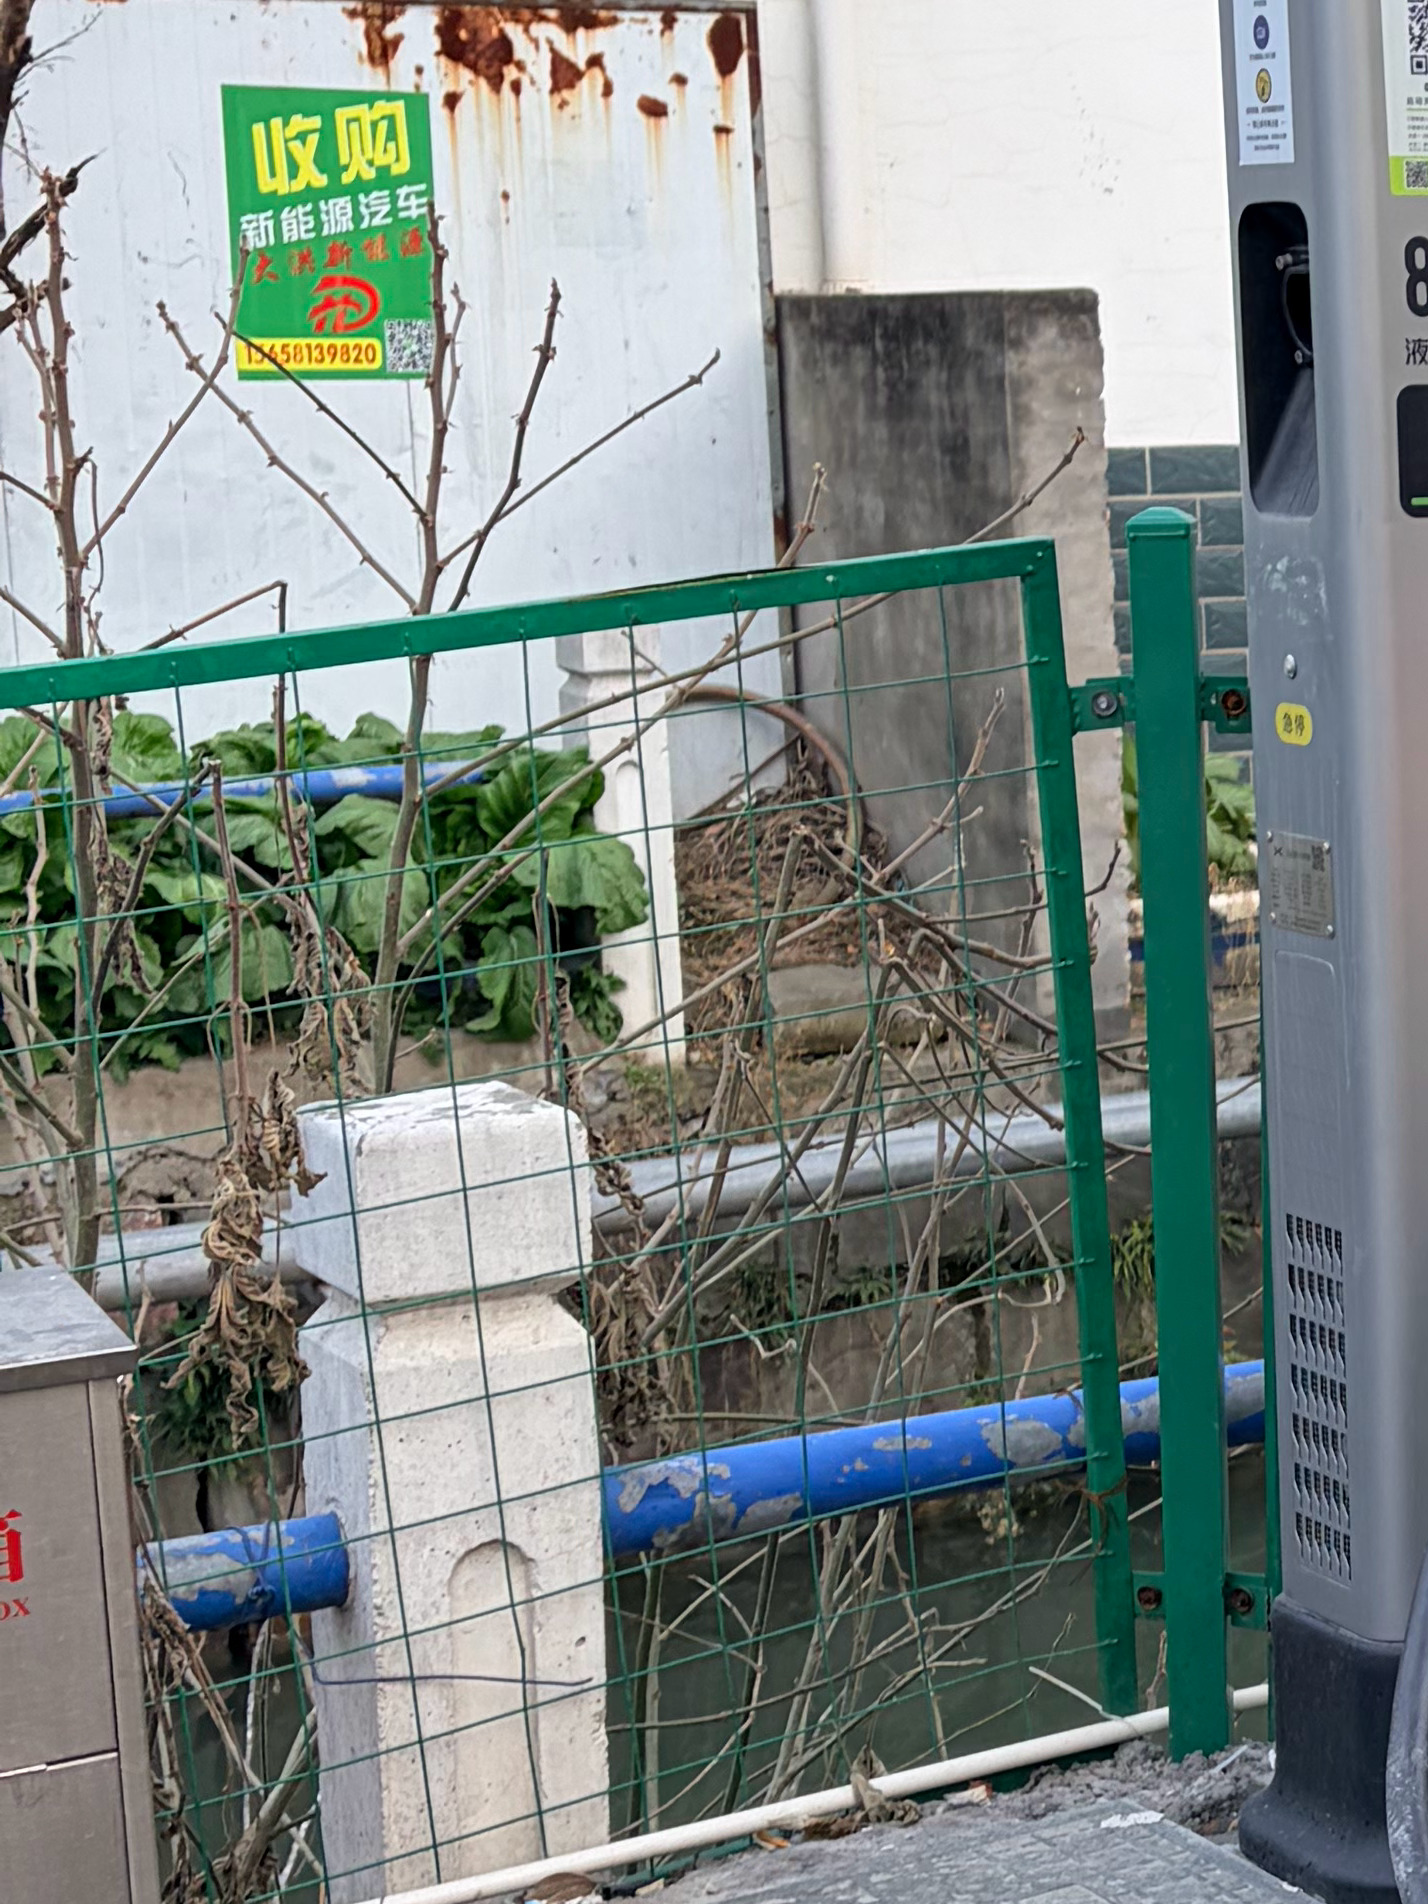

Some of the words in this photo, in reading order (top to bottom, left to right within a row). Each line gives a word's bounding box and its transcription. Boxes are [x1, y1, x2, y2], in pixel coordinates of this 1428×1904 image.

[251, 99, 411, 196] 收购
[240, 182, 429, 251] 新能源汽车
